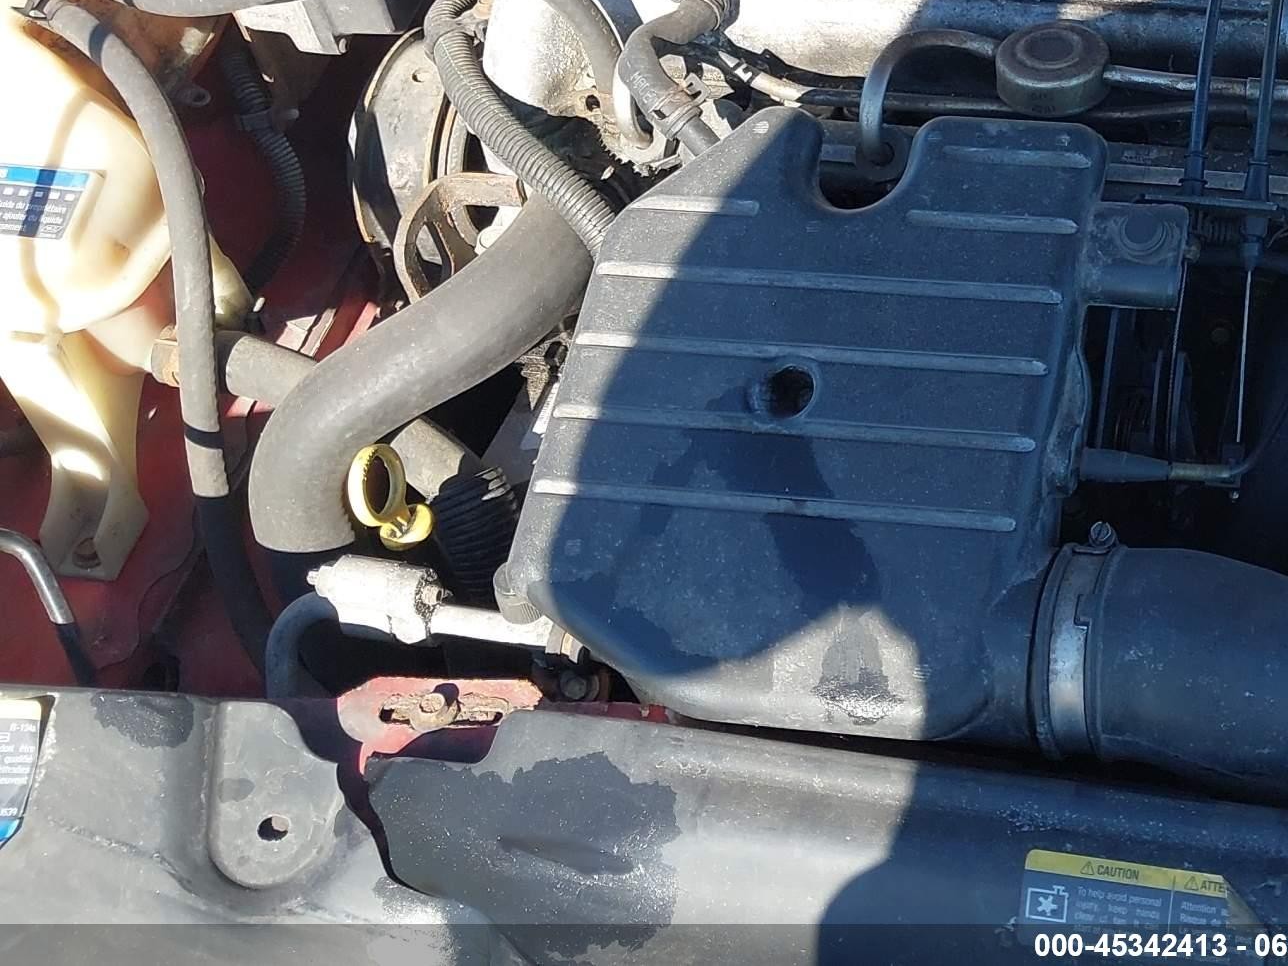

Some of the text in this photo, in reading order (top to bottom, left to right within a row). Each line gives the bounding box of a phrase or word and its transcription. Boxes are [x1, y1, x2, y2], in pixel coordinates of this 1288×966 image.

[1097, 864, 1140, 881] CAUTION
[1088, 888, 1105, 900] help
[1106, 890, 1127, 902] avoid
[1128, 893, 1162, 907] personal
